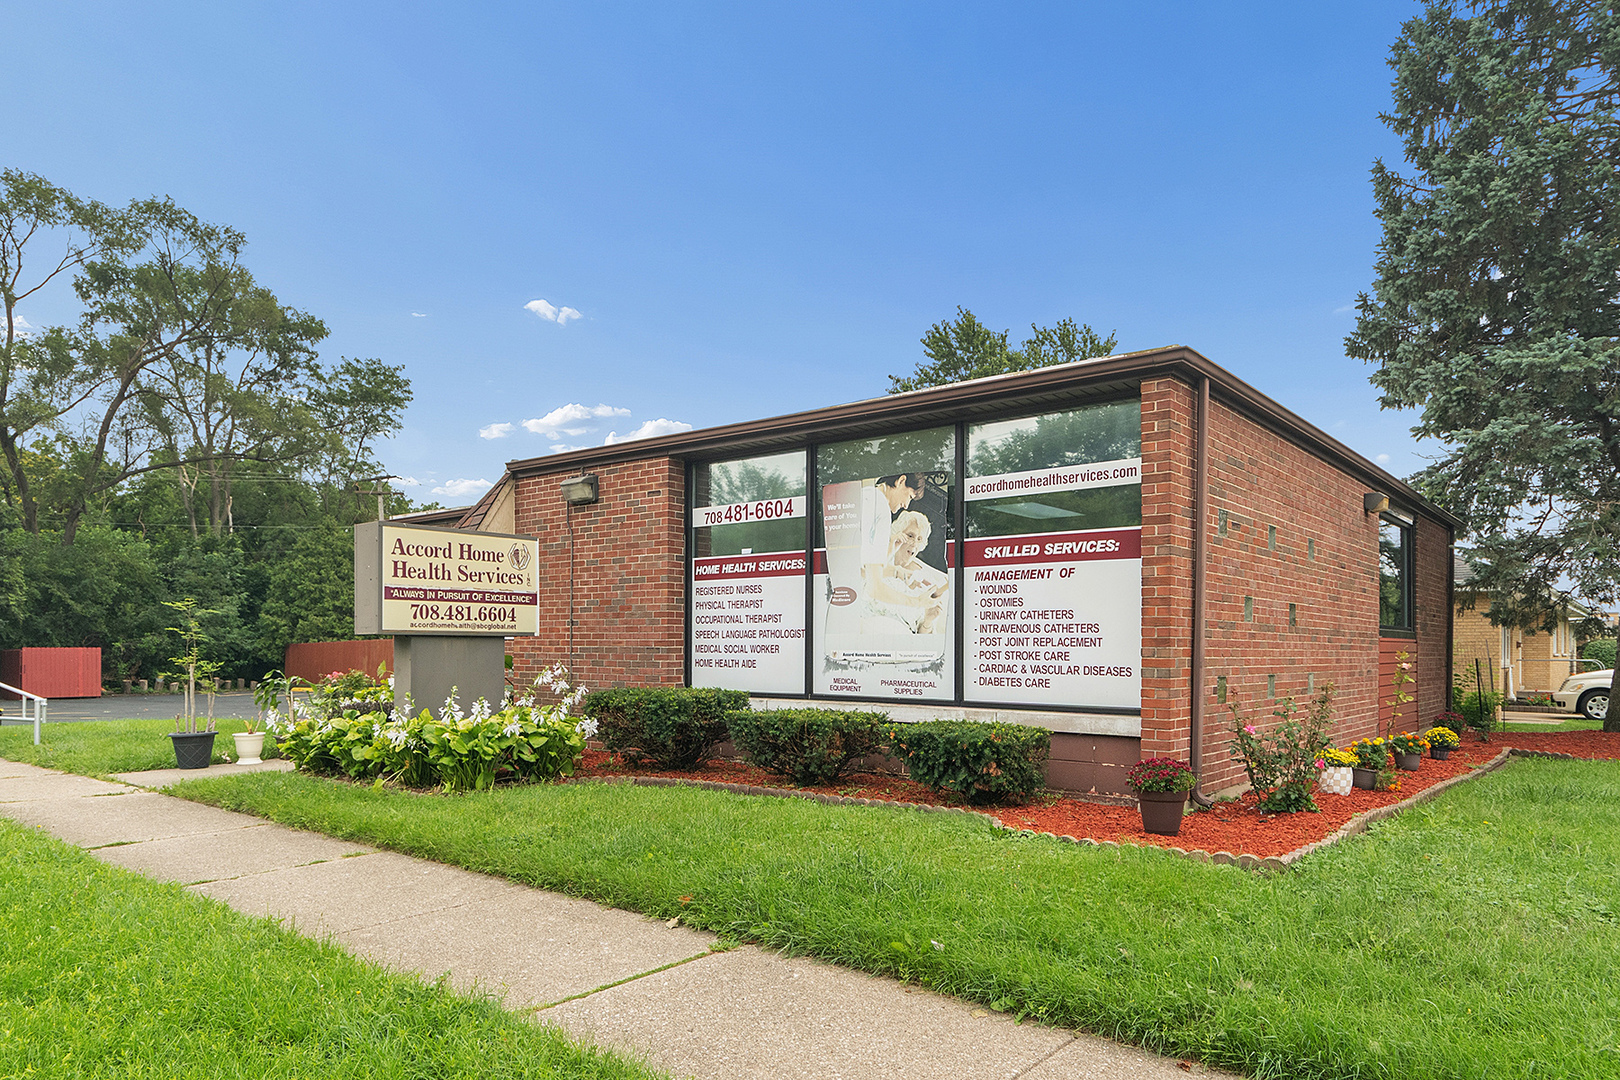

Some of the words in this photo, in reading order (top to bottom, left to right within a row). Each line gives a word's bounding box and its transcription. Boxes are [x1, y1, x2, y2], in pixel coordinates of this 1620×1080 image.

[970, 466, 1137, 494] accordhomehealthservices.com
[705, 511, 722, 525] 708
[725, 499, 794, 522] 481-6604
[391, 538, 452, 559] Accord
[459, 543, 504, 563] Home
[983, 544, 1040, 559] SKILLED
[1044, 539, 1120, 555] SERVICES:
[392, 560, 452, 581] Health
[458, 565, 523, 585] Services
[695, 564, 719, 575] HOME
[722, 561, 756, 574] HEALTH
[758, 559, 806, 572] SERVICES:
[974, 568, 1053, 582] MANAGEMENT
[1059, 568, 1075, 579] OF
[695, 586, 734, 596] REGISTERED
[736, 585, 762, 594] NURSES
[979, 584, 1018, 594] WOUNDS
[438, 592, 470, 600] PURSUIT
[472, 593, 483, 601] OF
[695, 601, 725, 610] PHYSICAL
[727, 600, 764, 610] THERAPIST
[980, 598, 1024, 607] OSTOMIES
[410, 604, 516, 622] 708.481.6604
[979, 610, 1017, 621] URINARY
[1020, 610, 1074, 620] CATHETERS
[695, 615, 743, 625] OCCUPATIONAL
[745, 614, 782, 624] THERAPIST
[695, 630, 720, 639] SPEECH
[722, 629, 757, 639] LANGUAGE
[758, 629, 805, 639] PATHOLOGIST
[979, 624, 1041, 634] INTRAVENOUS
[1043, 623, 1099, 634] CATHETERS
[979, 637, 1002, 647] POST
[1004, 637, 1030, 647] JOINT
[1033, 637, 1103, 648] REPLACEMENT
[695, 644, 722, 654] MEDICAL
[724, 644, 748, 654] SOCIAL
[749, 645, 780, 654] WORKER
[979, 650, 1002, 660] POST
[1004, 650, 1040, 661] STROKE
[1043, 651, 1070, 661] CARE
[695, 659, 713, 668] HOME
[715, 659, 739, 668] HEALTH
[741, 659, 757, 669] AIDE
[979, 664, 1018, 674] CARDIAC
[1020, 664, 1027, 674] &
[1030, 665, 1080, 676] VASCULAR
[1083, 666, 1132, 677] DISEASES
[880, 680, 937, 688] PHARMACEUTICAL
[979, 677, 1022, 688] DIABETES
[1025, 678, 1050, 688] CARE
